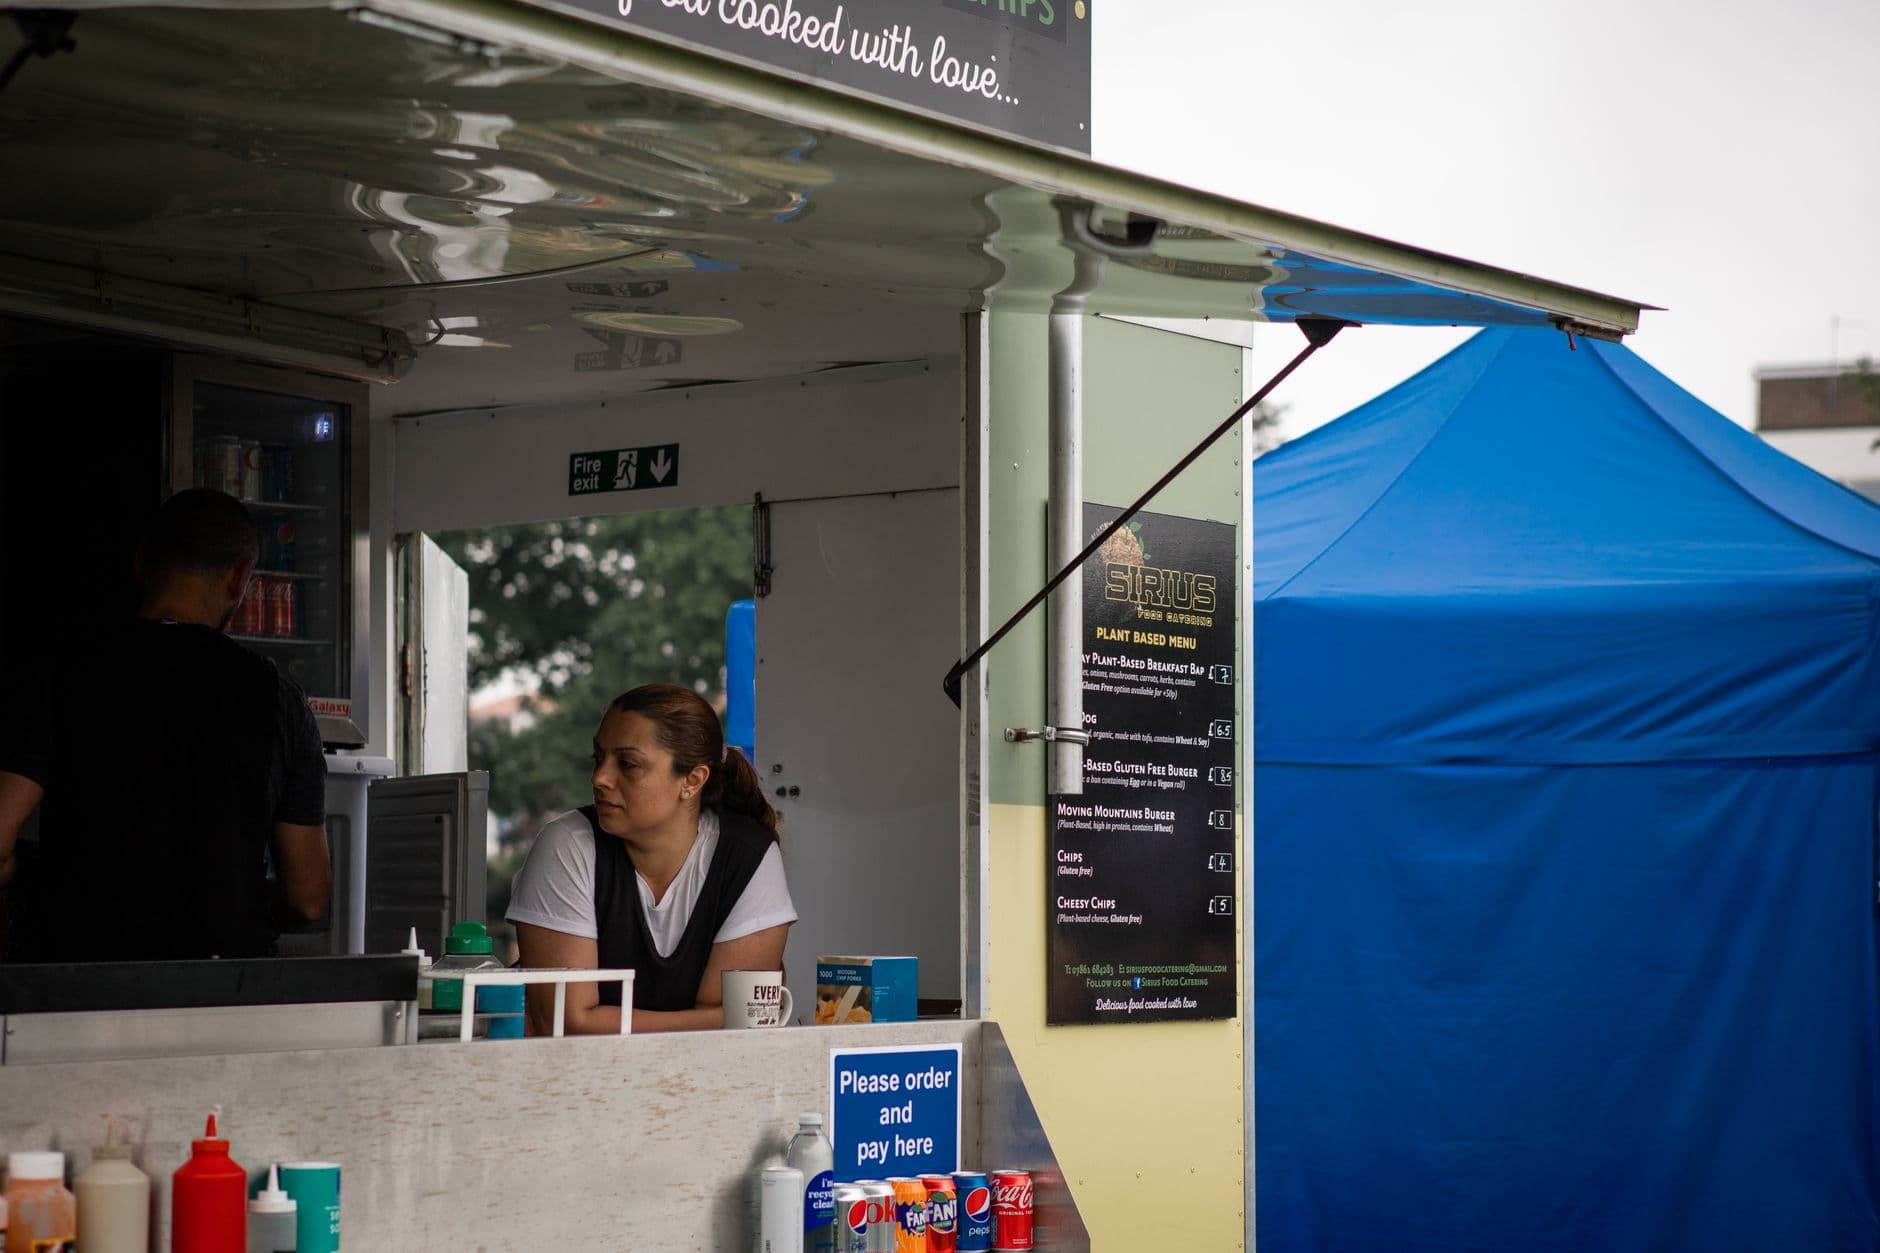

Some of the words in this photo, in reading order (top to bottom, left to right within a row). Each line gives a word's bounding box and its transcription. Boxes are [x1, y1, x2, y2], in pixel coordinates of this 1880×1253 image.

[718, 0, 844, 54] cooked
[850, 24, 924, 77] with
[574, 457, 602, 473] Fire
[573, 474, 600, 491] exit
[1105, 562, 1216, 613] SIRIUS
[1137, 609, 1163, 621] FOOD
[1166, 612, 1213, 627] CATERING
[1096, 627, 1130, 642] PLANT
[1133, 631, 1166, 646] BASED
[1168, 635, 1197, 650] MENU
[1101, 683, 1113, 692] Free
[1153, 687, 1163, 698] for
[309, 699, 350, 717] Galaxy
[1130, 732, 1141, 741] with
[1175, 735, 1193, 745] Wheat
[1129, 778, 1140, 789] Egg
[1110, 914, 1129, 924] Gluten
[819, 970, 833, 978] 1000
[1095, 998, 1128, 1011] Delicious
[1127, 997, 1145, 1014] food
[1145, 997, 1168, 1009] cooked
[1168, 996, 1182, 1009] with
[1182, 996, 1198, 1008] love
[840, 1069, 900, 1095] Please
[904, 1066, 952, 1091] order
[879, 1100, 912, 1125] and
[857, 1140, 889, 1166] pay
[894, 1134, 933, 1158] here
[867, 1195, 896, 1224] ok
[906, 1208, 926, 1227] FAN
[968, 1227, 990, 1237] peps
